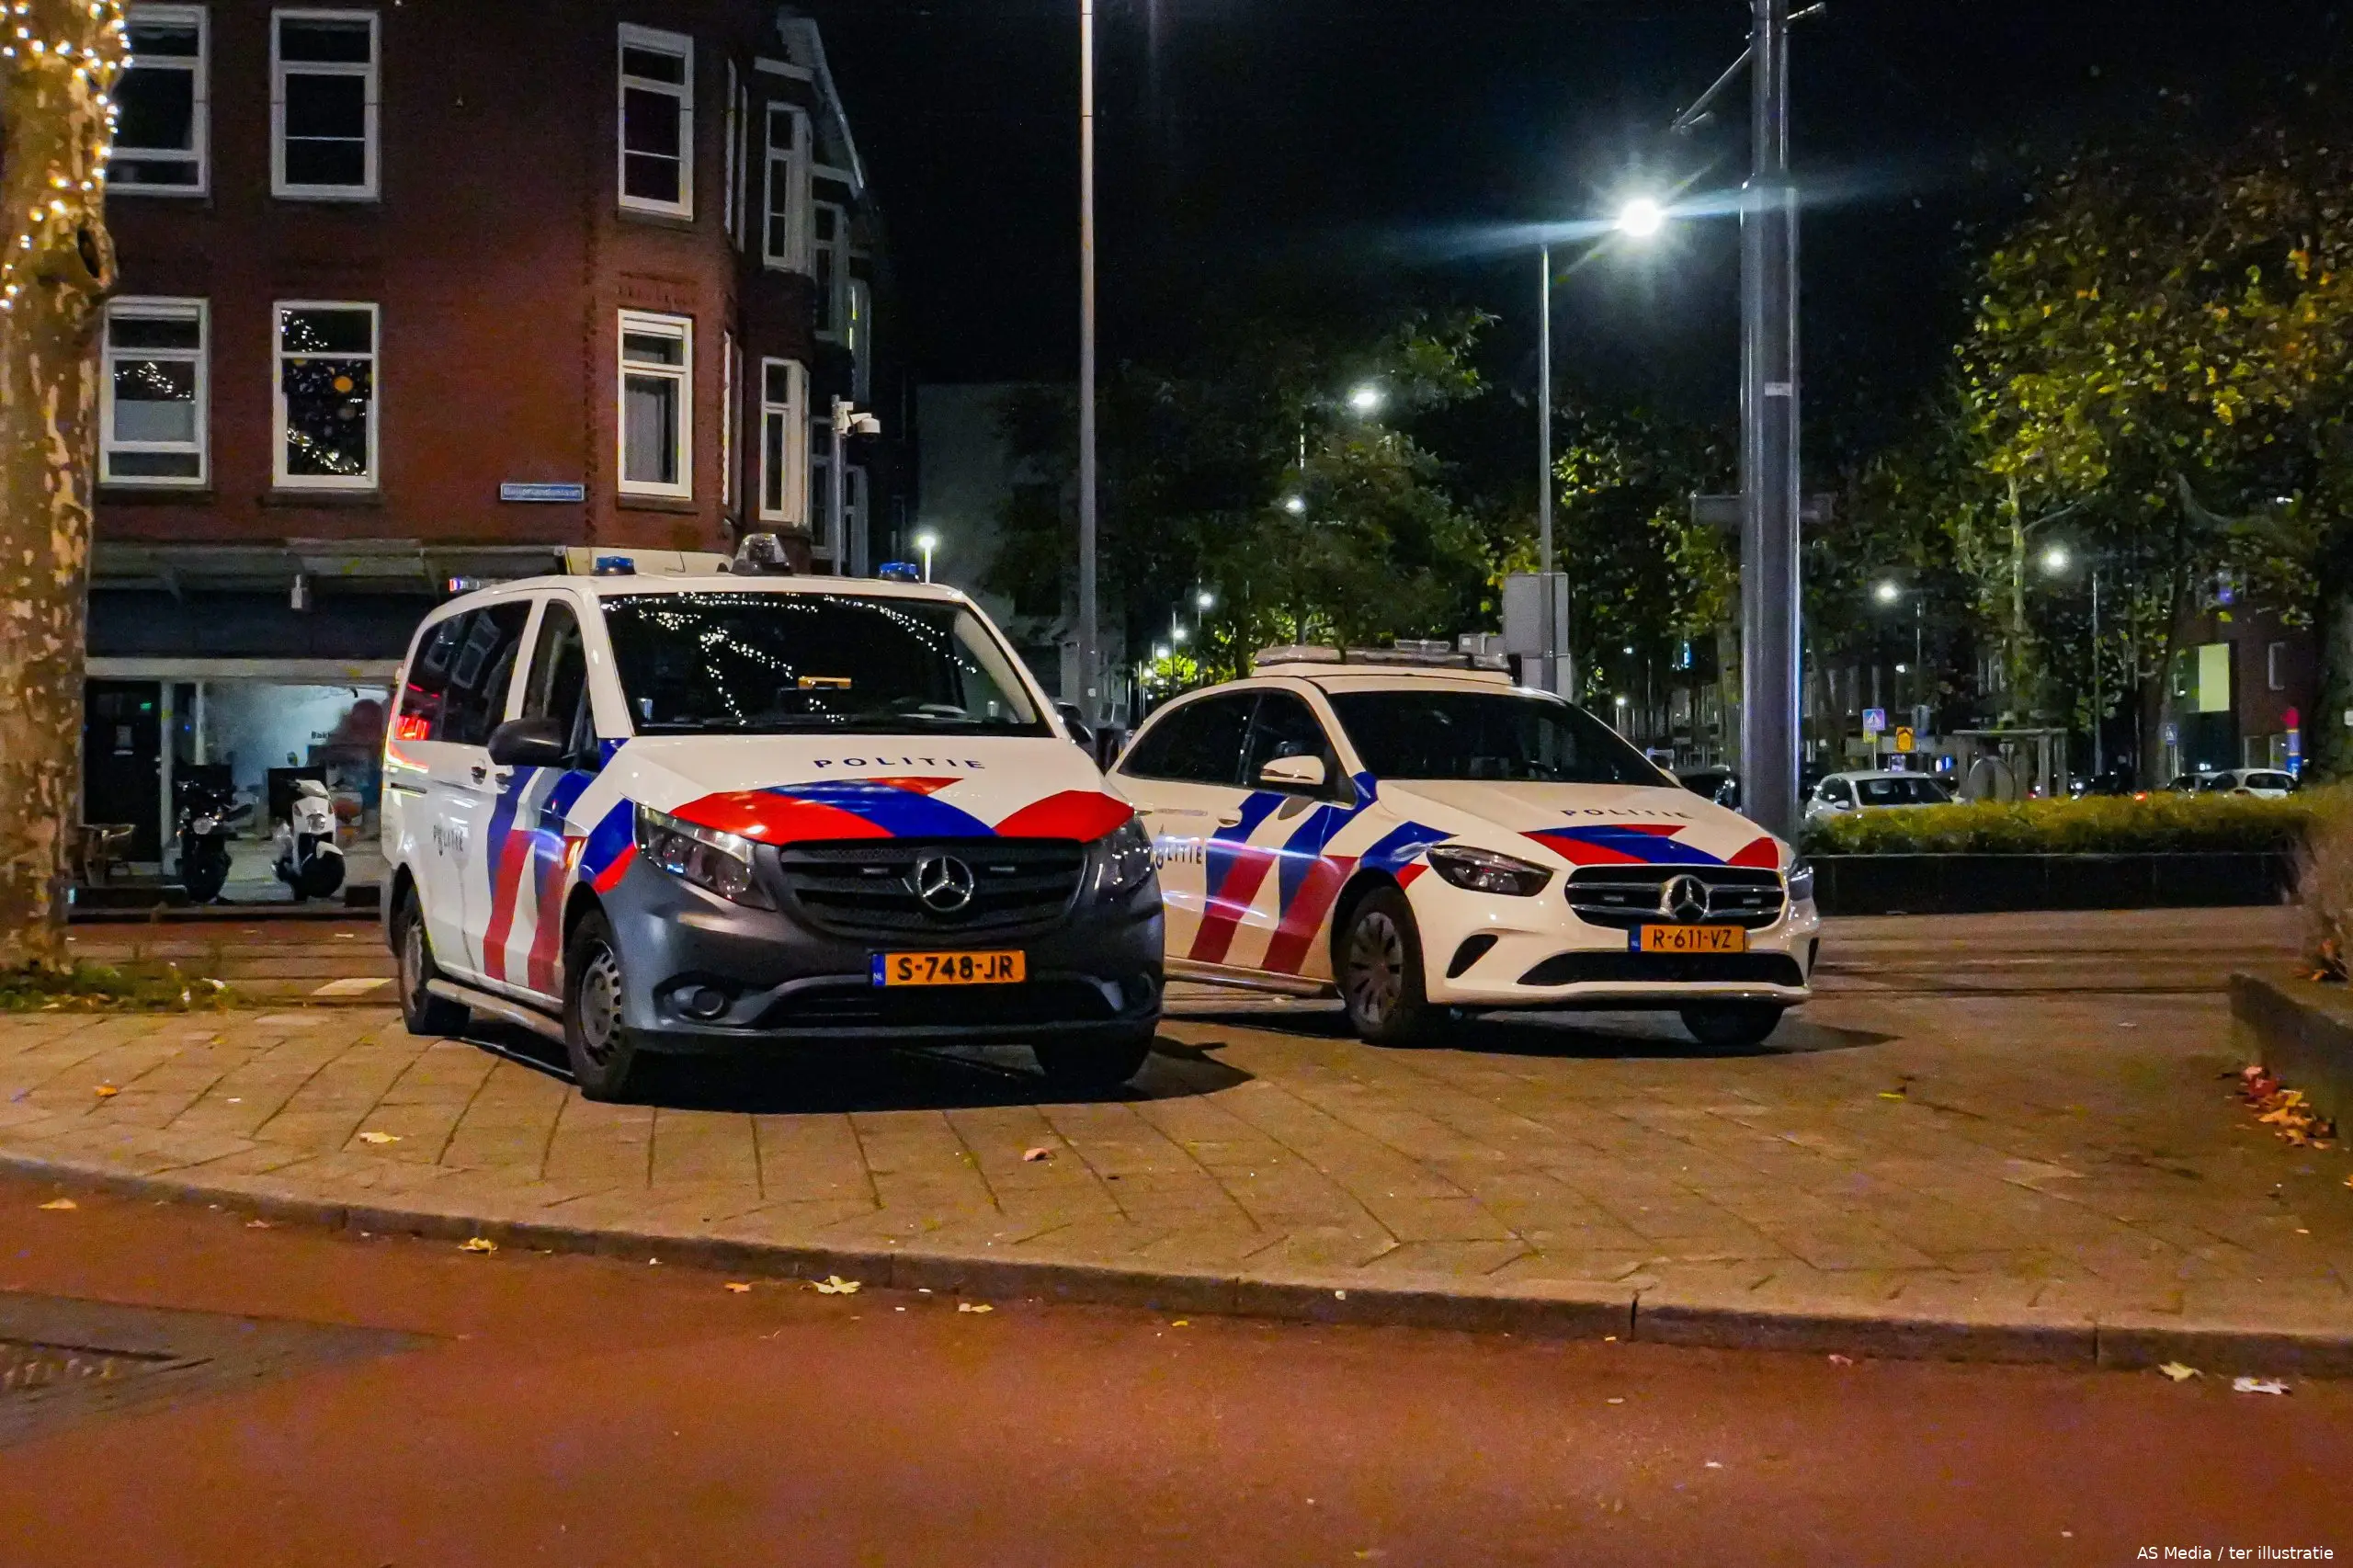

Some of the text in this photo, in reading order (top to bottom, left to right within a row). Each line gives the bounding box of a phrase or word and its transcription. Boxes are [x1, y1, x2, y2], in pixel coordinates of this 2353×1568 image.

[813, 757, 985, 769] POLITIE
[1561, 809, 1695, 820] POLITIE
[1653, 928, 1733, 949] R-611-VZ
[872, 955, 1014, 982] NL S-748-JR
